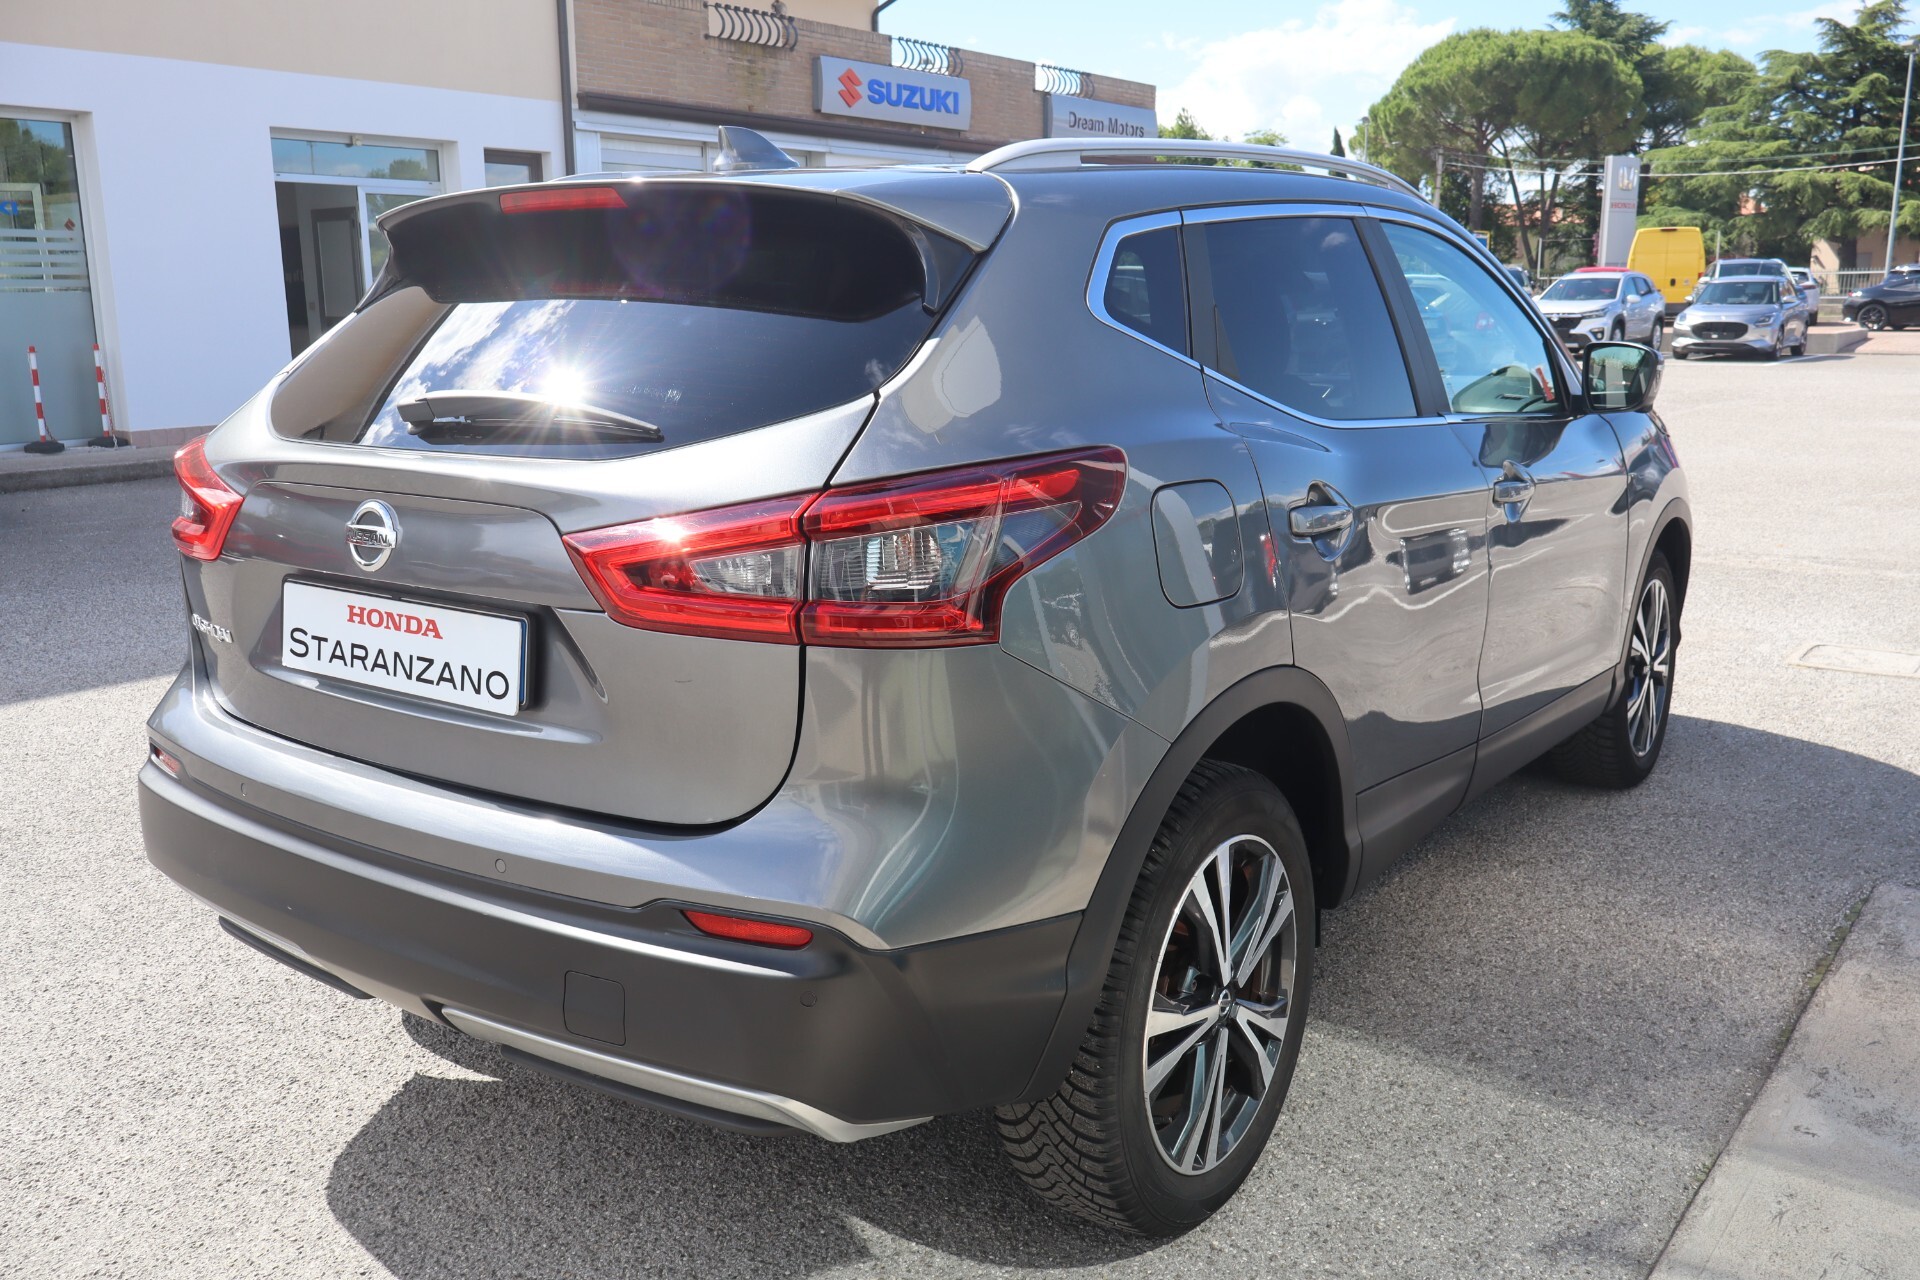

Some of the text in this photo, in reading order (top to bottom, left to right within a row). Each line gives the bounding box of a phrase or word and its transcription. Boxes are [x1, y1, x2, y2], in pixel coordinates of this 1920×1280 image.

[867, 79, 959, 115] SUZUKI
[1069, 111, 1145, 138] Dream Motors
[347, 604, 443, 640] HONDA
[289, 627, 510, 700] STARANZANO
